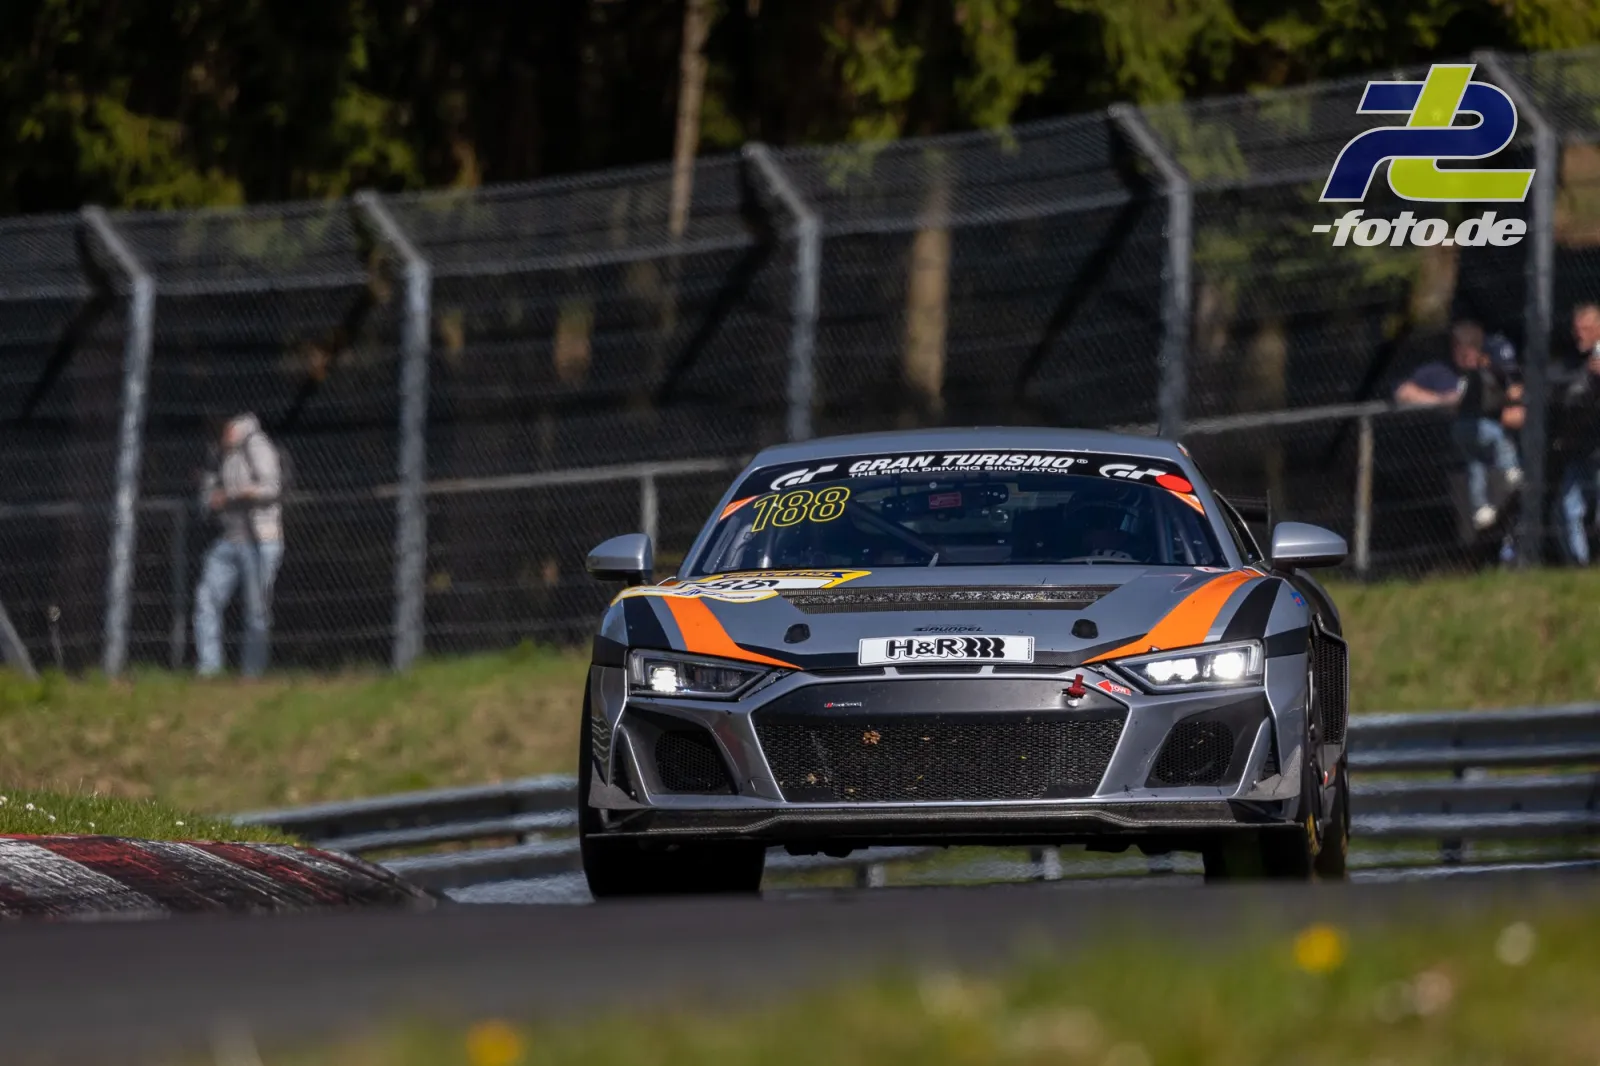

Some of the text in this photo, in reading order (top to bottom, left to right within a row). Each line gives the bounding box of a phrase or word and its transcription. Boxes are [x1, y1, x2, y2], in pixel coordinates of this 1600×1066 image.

[848, 455, 936, 473] GRAN
[849, 470, 877, 478] THE
[881, 467, 918, 475] REAL
[984, 465, 1068, 474] SIMULATOR
[751, 486, 851, 532] 188
[886, 637, 965, 660] H&R
